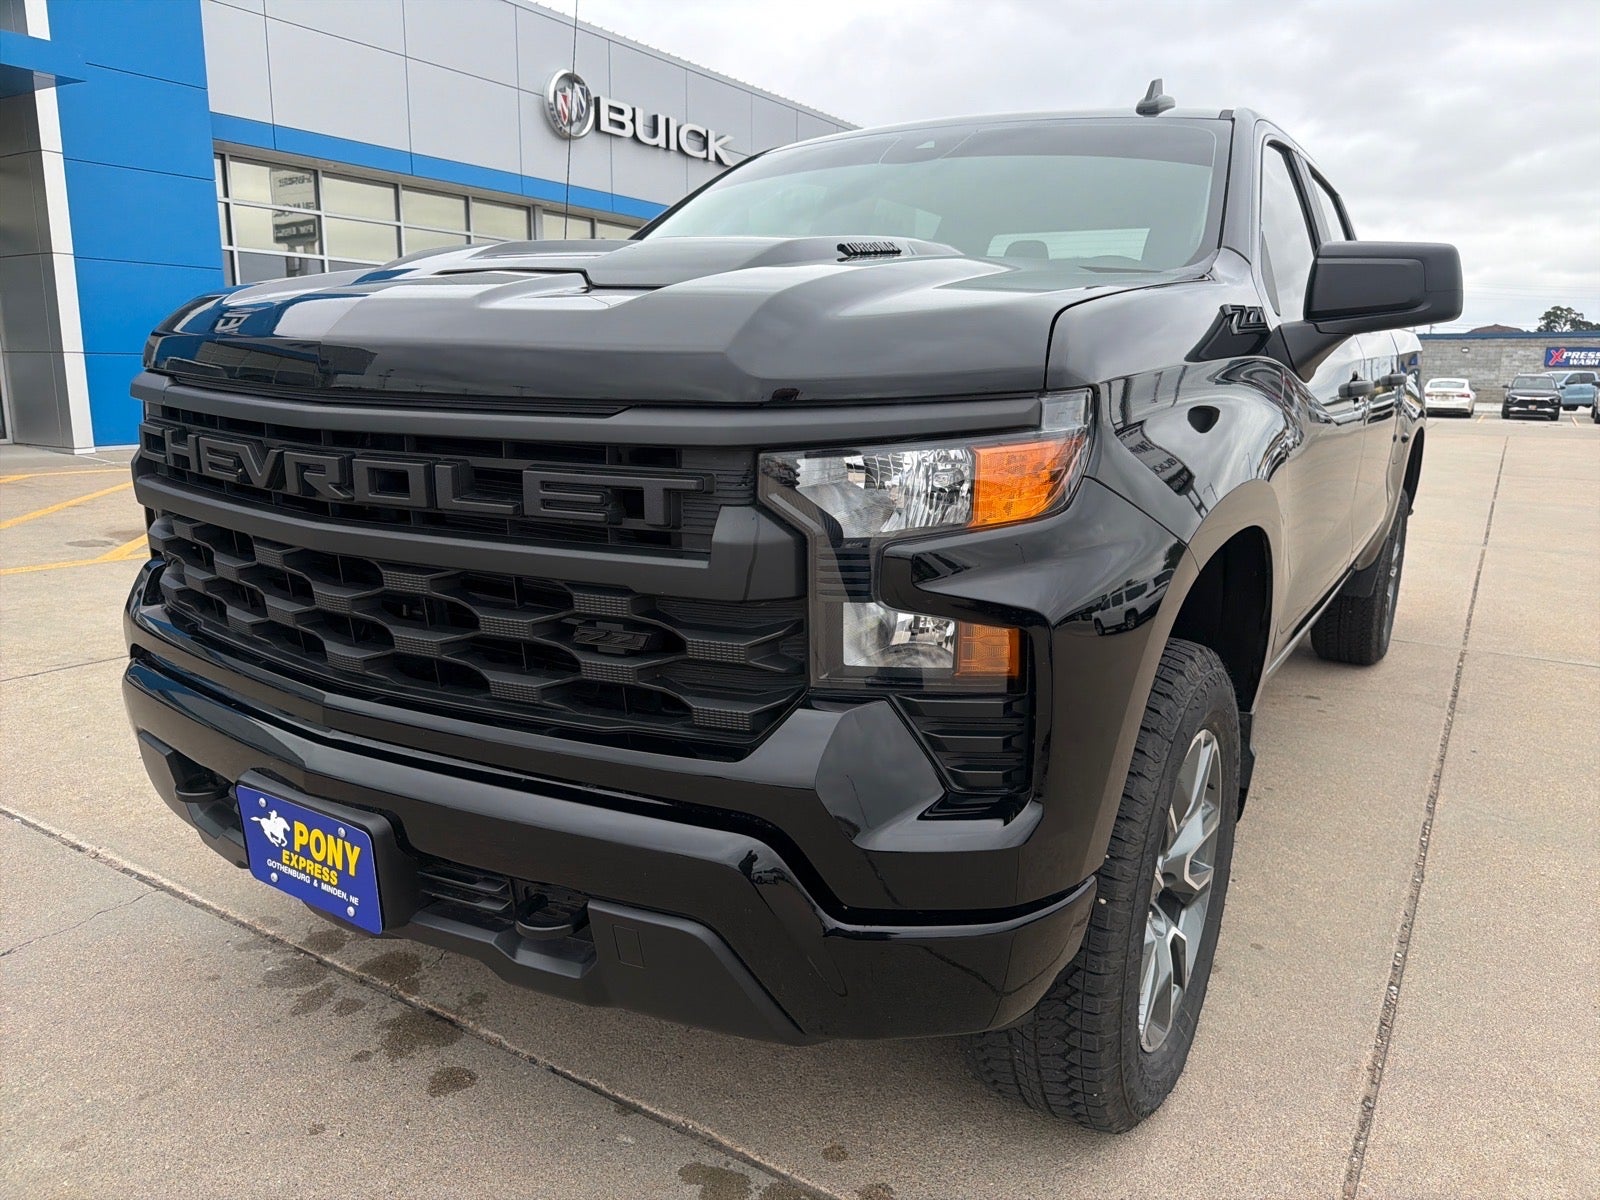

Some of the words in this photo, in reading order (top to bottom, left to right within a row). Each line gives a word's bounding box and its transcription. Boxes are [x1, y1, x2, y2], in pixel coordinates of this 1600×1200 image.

[597, 96, 735, 167] BUICK
[139, 420, 714, 529] CHEVROLET
[282, 849, 338, 886] EXPRESS
[293, 820, 361, 877] PONY
[266, 858, 311, 884] GOTHENBURG
[313, 879, 318, 888] &
[321, 882, 348, 903] MINDEN,
[350, 896, 359, 906] NE
